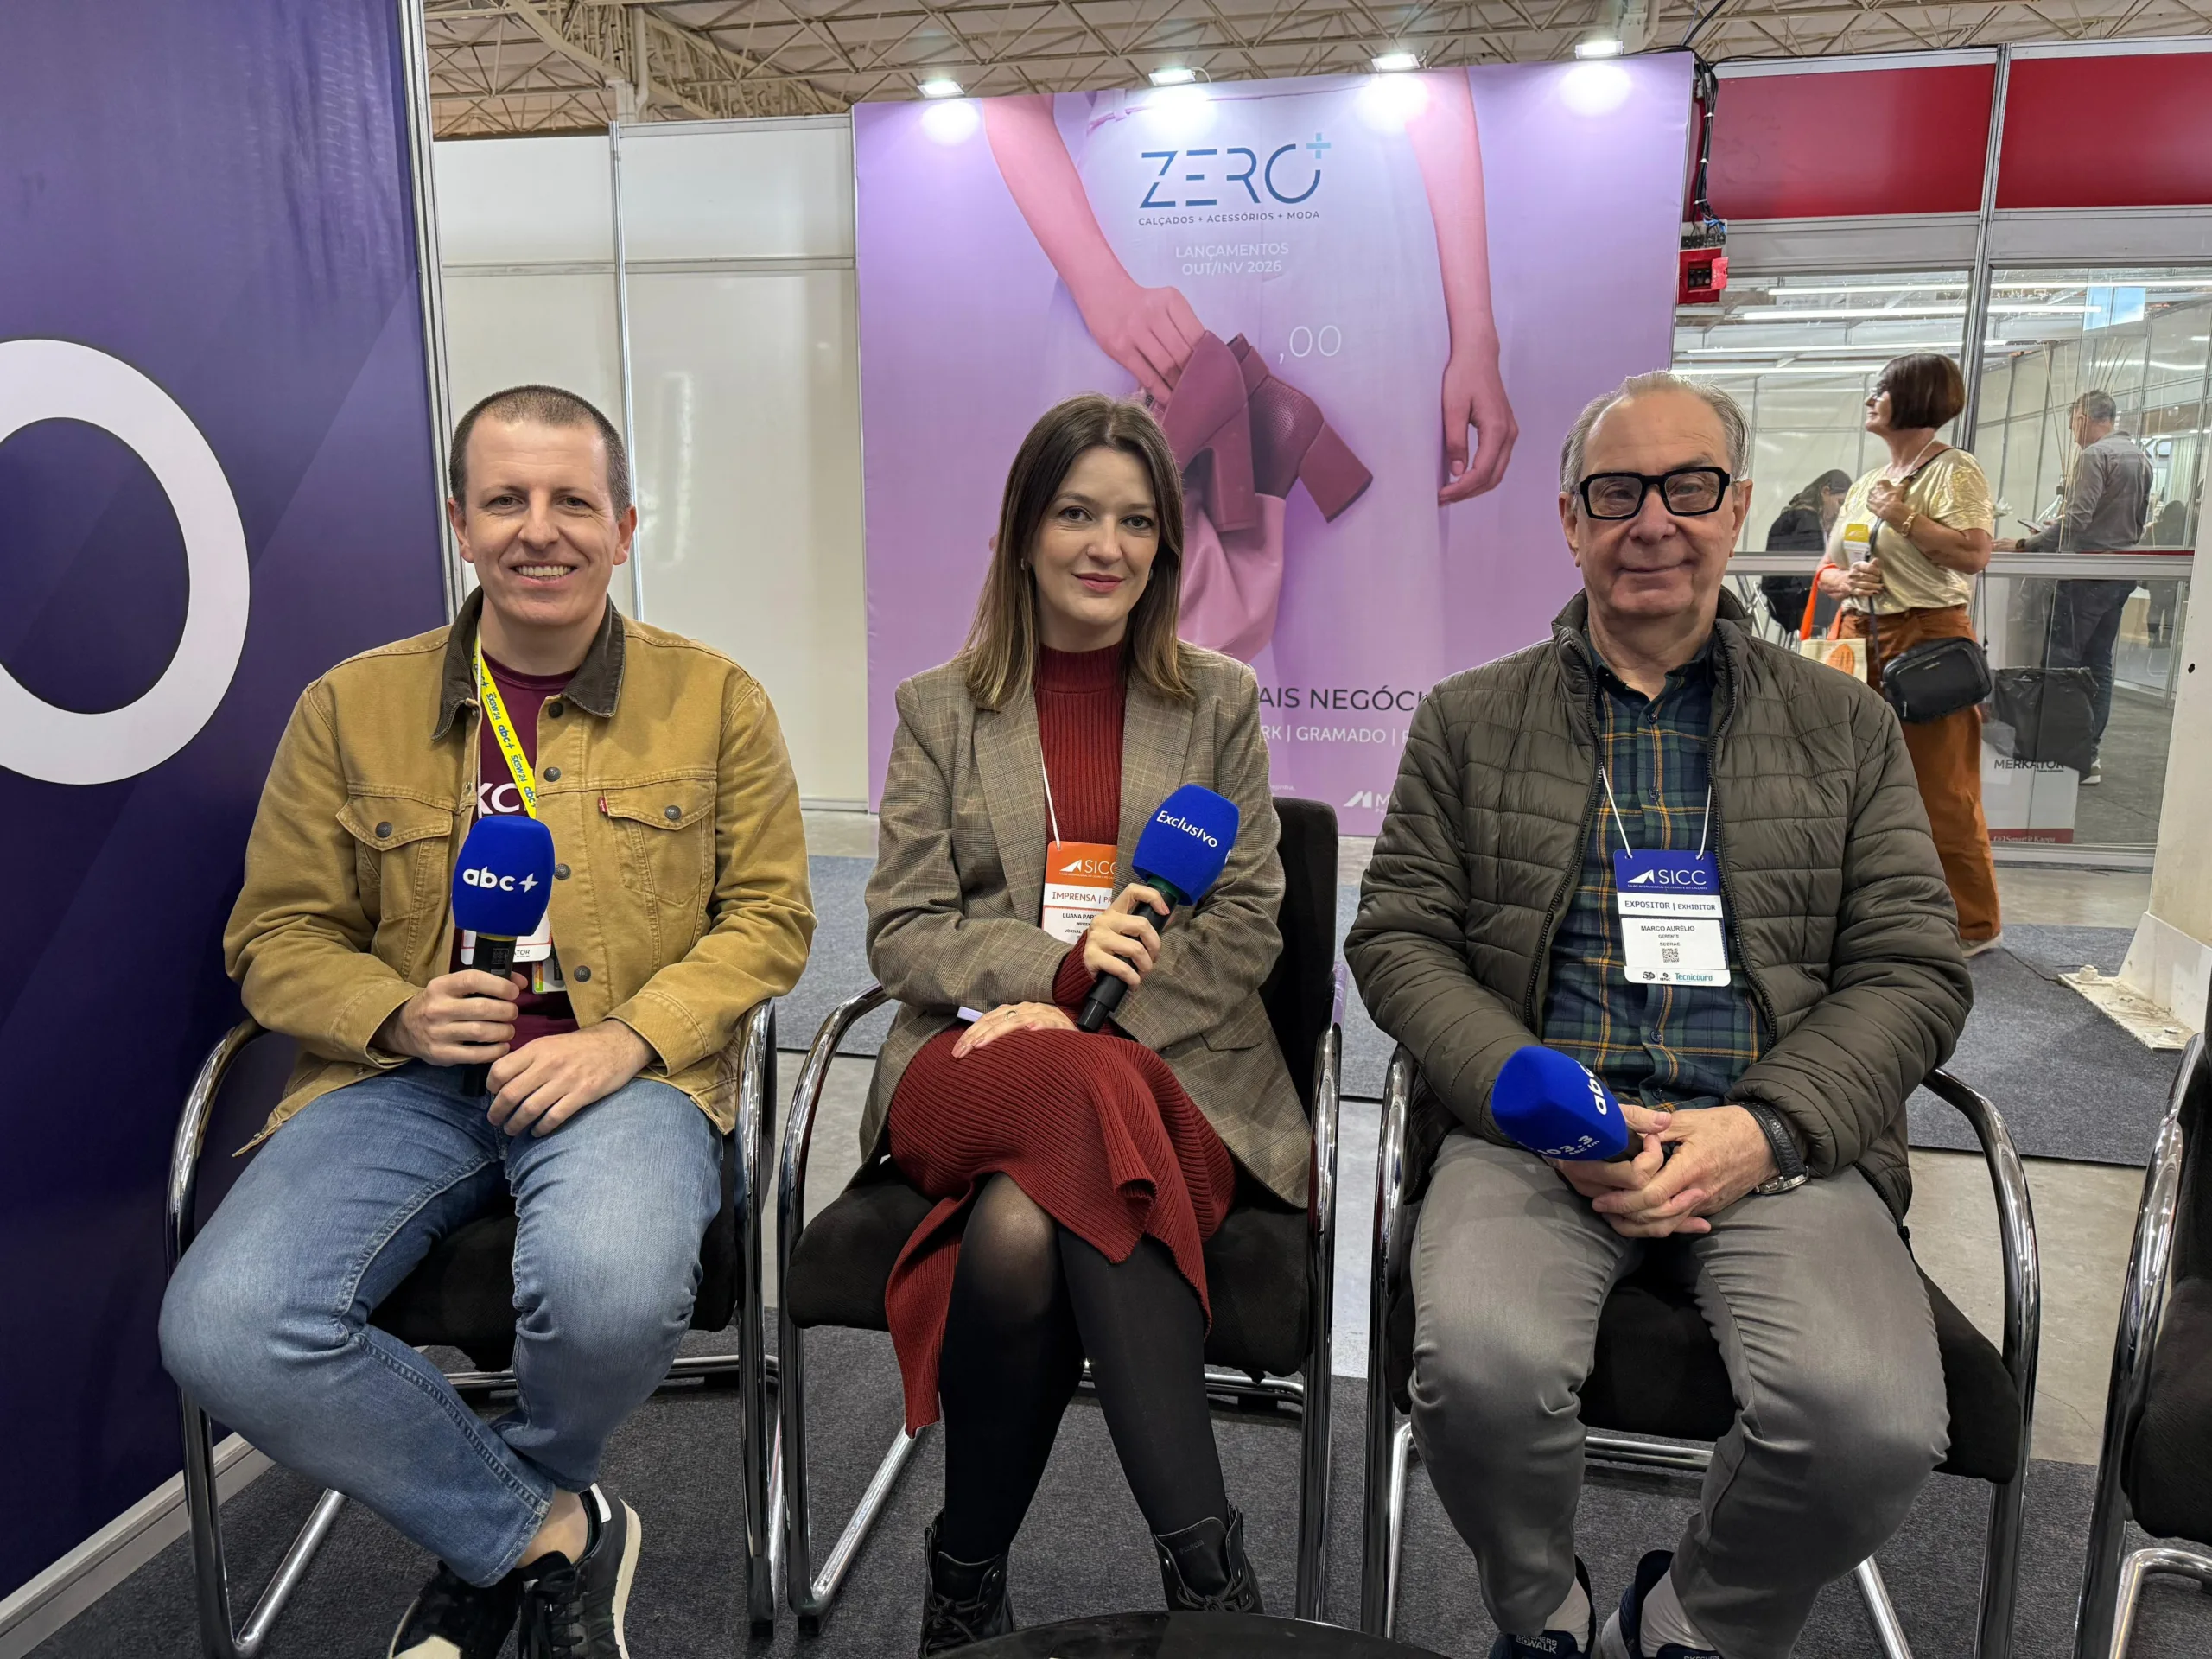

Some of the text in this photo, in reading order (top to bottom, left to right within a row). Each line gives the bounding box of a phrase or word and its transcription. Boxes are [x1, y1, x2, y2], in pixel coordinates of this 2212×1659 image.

[1138, 216, 1194, 226] CALÇADOS
[1207, 212, 1274, 223] ACESSÓRIOS
[1287, 211, 1320, 219] MODA
[1175, 243, 1289, 260] LANÇAMENTOS
[1182, 260, 1282, 276] OUT/INV 2026
[1296, 726, 1386, 744] GRAMADO
[1658, 869, 1707, 886] SICC
[1052, 892, 1096, 902] IMPRENSA
[1624, 900, 1671, 910] EXPOSITOR
[1675, 972, 1713, 982] Tecnicouro
